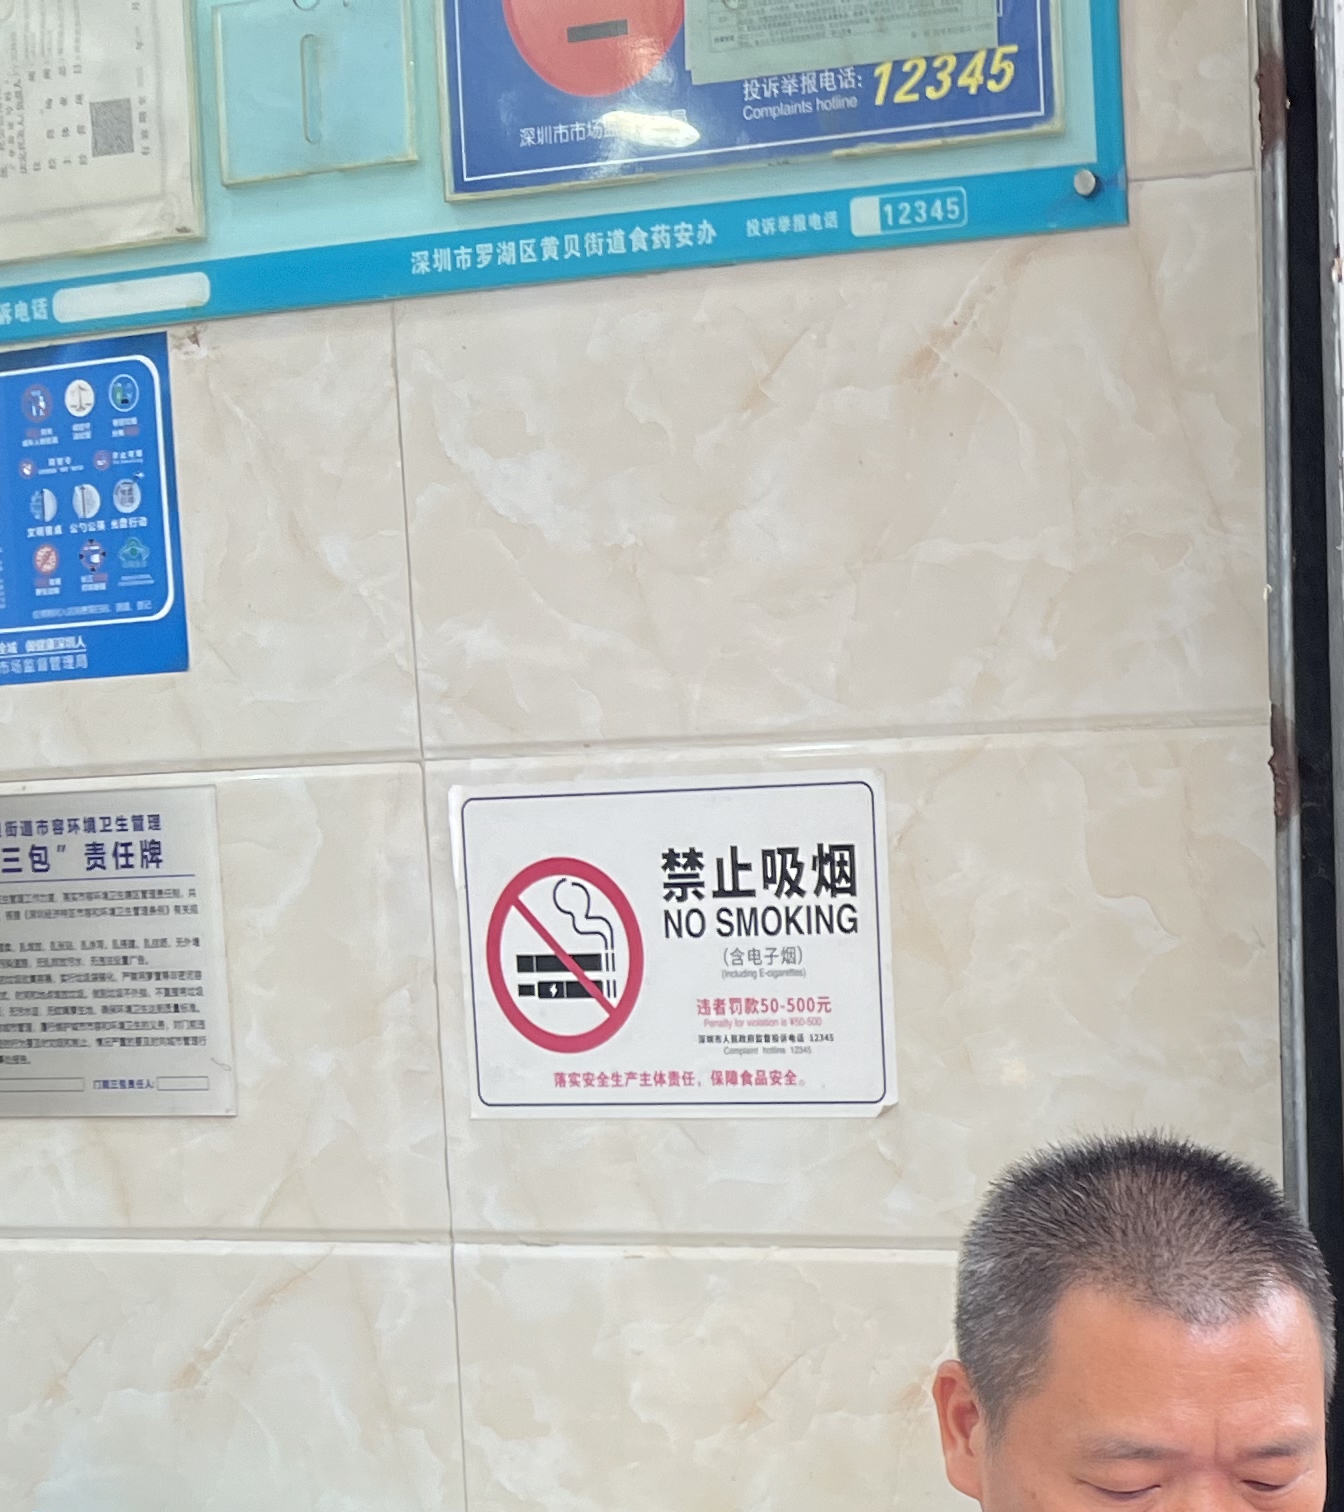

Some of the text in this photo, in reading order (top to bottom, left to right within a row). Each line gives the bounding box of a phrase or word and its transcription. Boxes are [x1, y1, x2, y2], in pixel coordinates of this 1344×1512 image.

[873, 44, 1018, 106] 12345
[743, 94, 858, 121] Complaints hotline
[410, 219, 717, 275] 深圳市罗湖区黄贝街道食药安办
[883, 197, 960, 226] 12345
[0, 814, 162, 837] 街道市容环境卫生管理
[661, 843, 857, 902] 禁止吸烟
[664, 903, 858, 938] NO SMOKING
[696, 996, 832, 1016] 违者罚款50-500元
[809, 1033, 834, 1042] 12345
